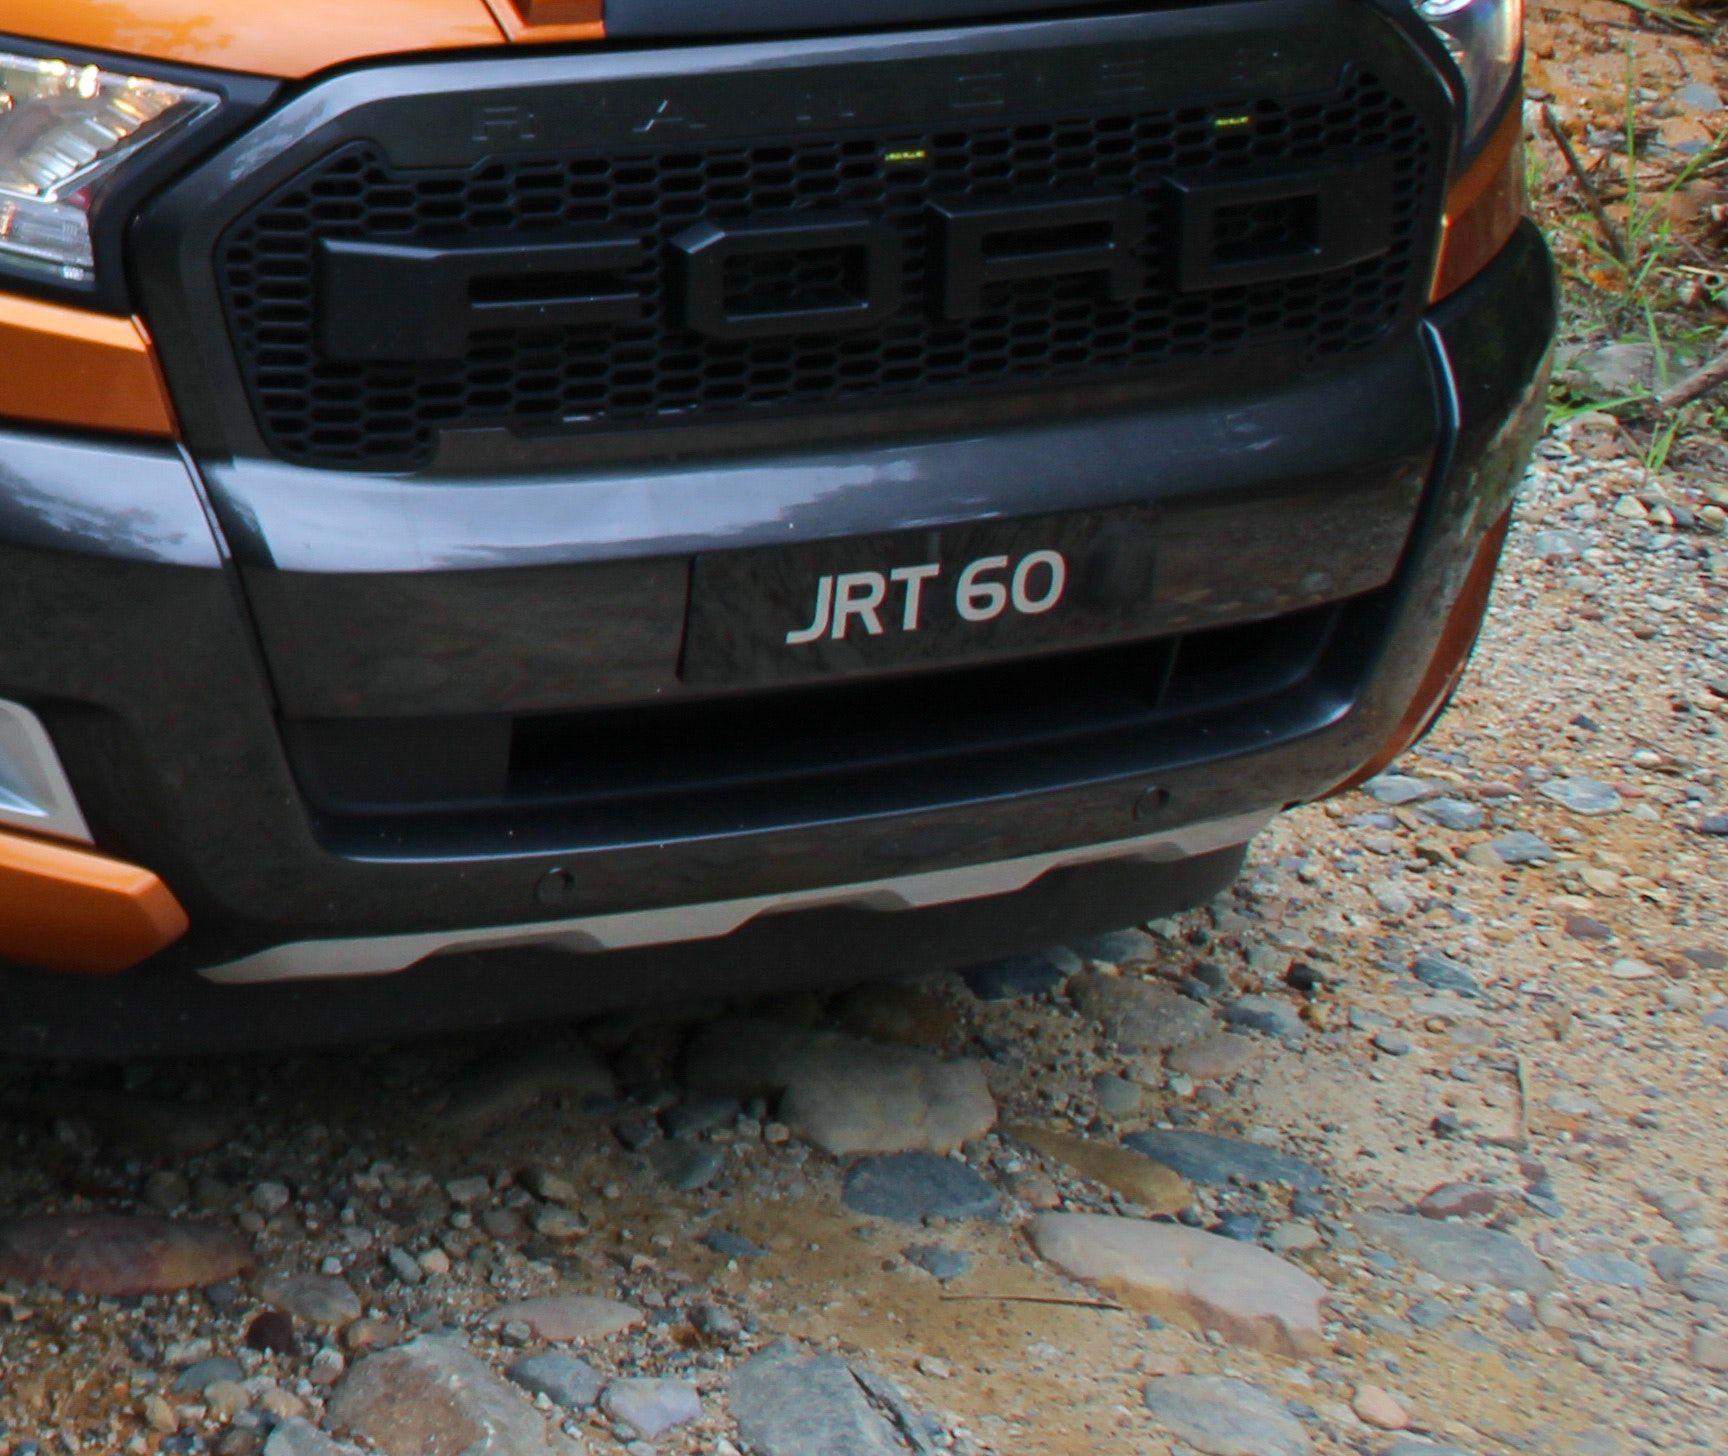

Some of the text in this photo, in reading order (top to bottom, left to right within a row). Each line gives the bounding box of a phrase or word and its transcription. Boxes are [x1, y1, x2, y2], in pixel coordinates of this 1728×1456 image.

[320, 162, 1394, 362] FORD
[785, 549, 1067, 645] JRT 60
